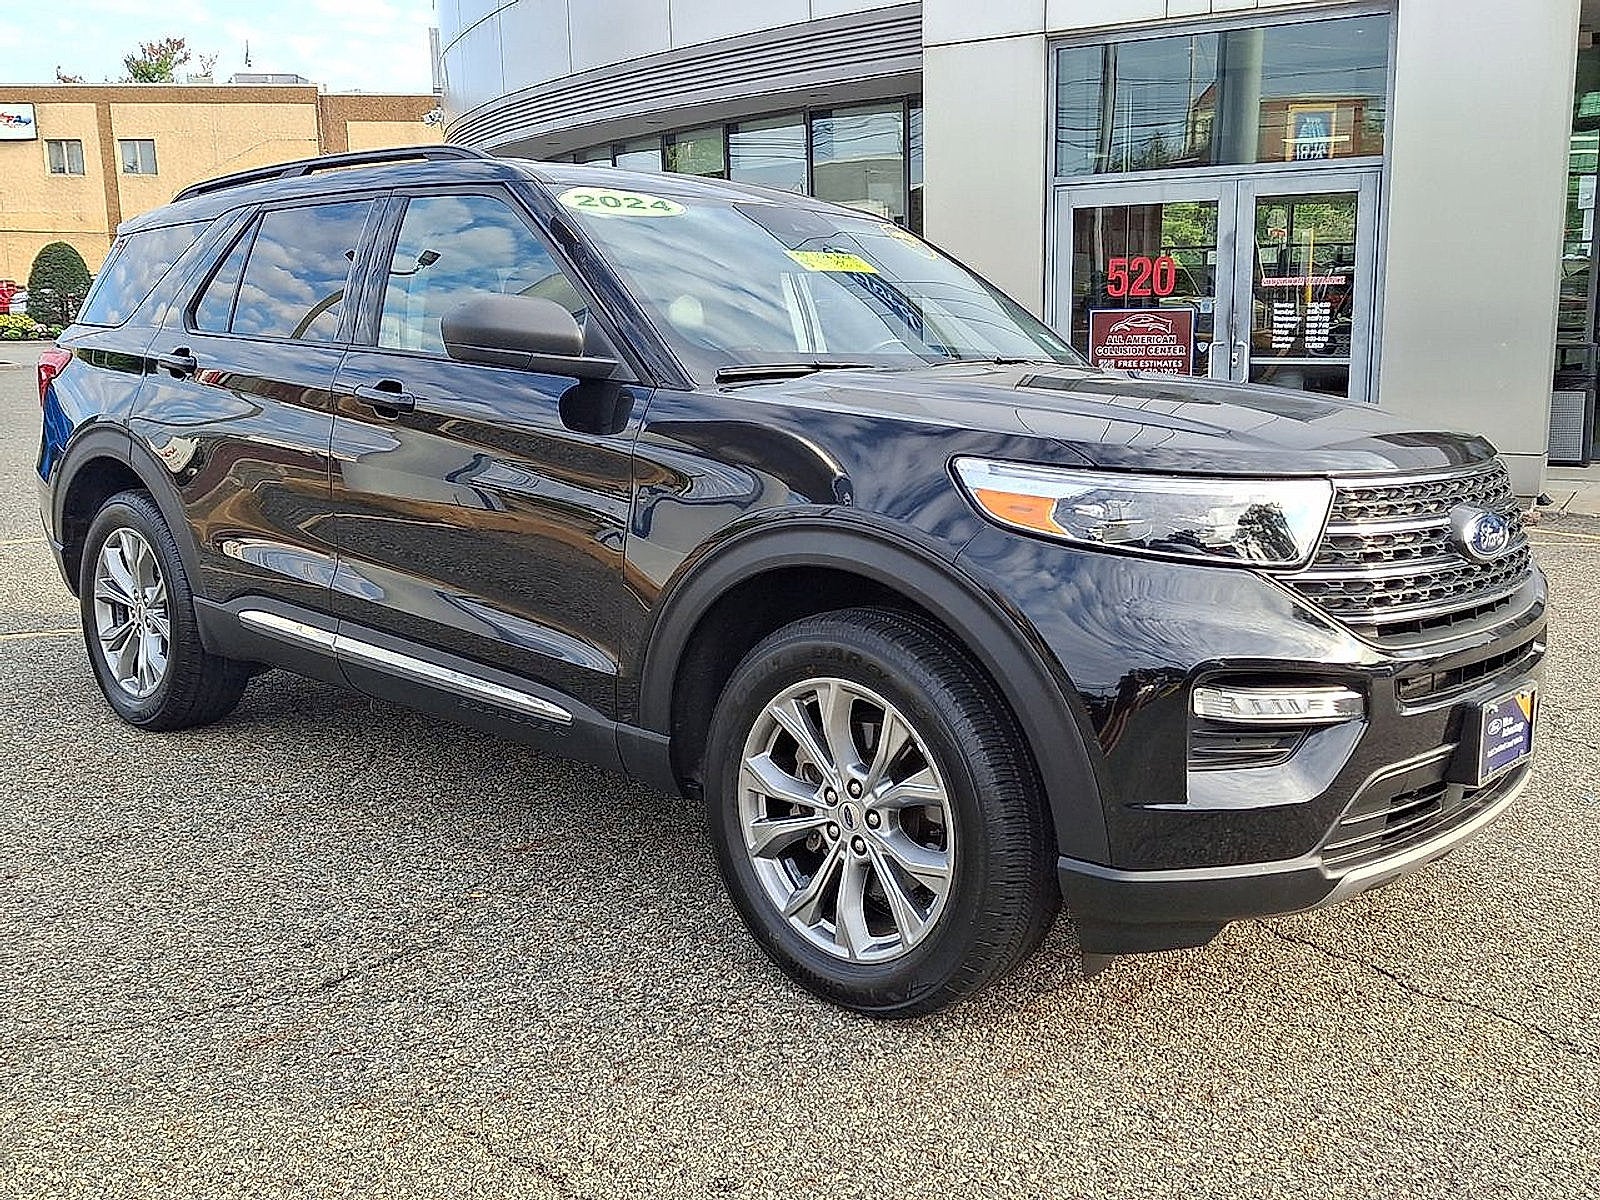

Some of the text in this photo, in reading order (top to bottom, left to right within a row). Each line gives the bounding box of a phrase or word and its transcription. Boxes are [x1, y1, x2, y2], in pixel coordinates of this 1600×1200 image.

[574, 195, 671, 211] 2024
[1107, 256, 1175, 296] 520
[1106, 335, 1177, 345] ALL AMERICAN
[1095, 345, 1186, 356] COLLISION CENTER
[1117, 360, 1183, 368] FREE ESTIMATES
